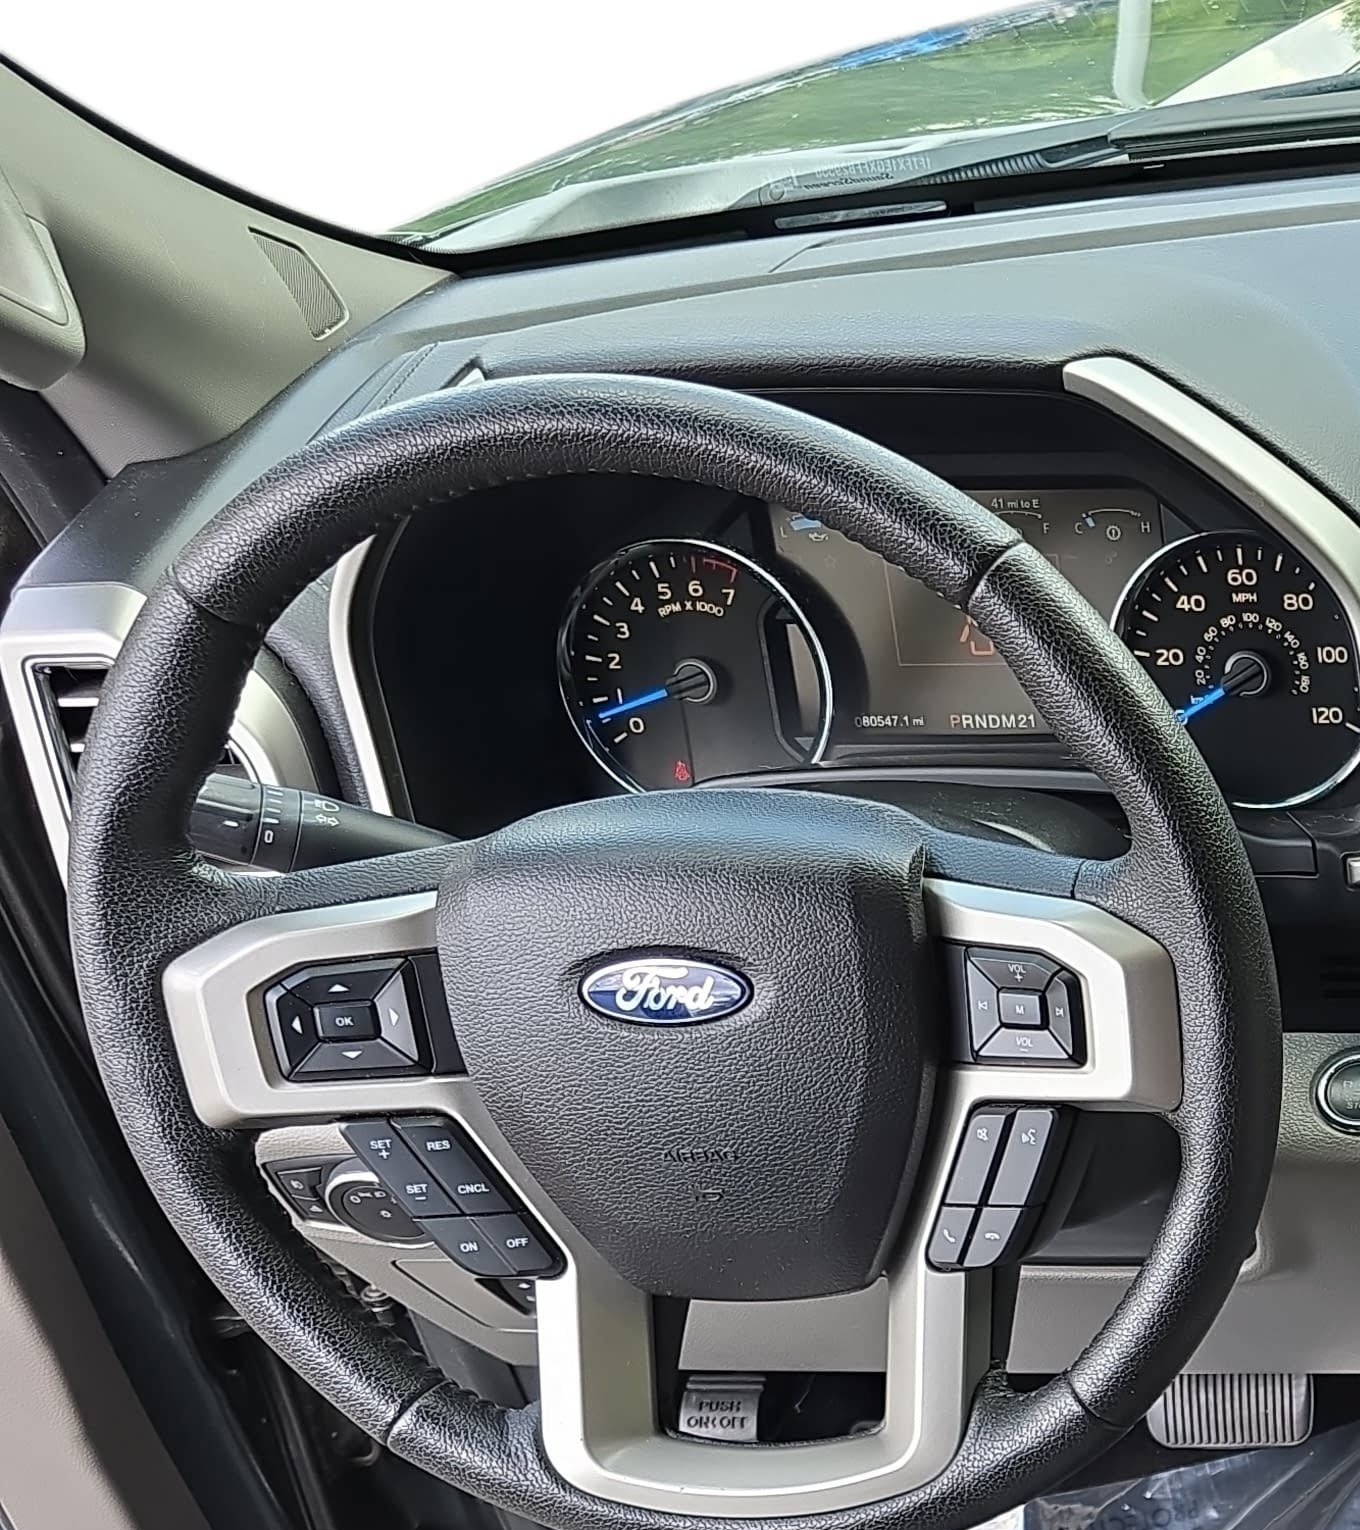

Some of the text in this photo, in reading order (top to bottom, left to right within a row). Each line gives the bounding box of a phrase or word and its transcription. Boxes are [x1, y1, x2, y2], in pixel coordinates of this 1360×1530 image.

[991, 498, 1005, 508] 41
[1043, 523, 1050, 534] F
[1227, 568, 1258, 586] 60
[657, 583, 672, 601] 5
[687, 580, 704, 597] 6
[721, 588, 736, 606] 7
[629, 597, 645, 614] 4
[1175, 594, 1206, 612] 40
[1232, 592, 1258, 603] MPH
[1283, 593, 1314, 611] 80
[658, 601, 724, 619] RPM X 1000
[1242, 612, 1260, 624] 100
[1219, 614, 1237, 629] 80
[1264, 615, 1283, 633] 120
[615, 622, 631, 639] 3
[1203, 626, 1219, 643] 60
[1283, 630, 1301, 649] 140
[607, 653, 622, 670] 2
[1155, 648, 1185, 666] 20
[1194, 646, 1207, 664] 40
[1296, 651, 1310, 671] 160
[1316, 646, 1349, 664] 100
[1194, 669, 1207, 686] 20
[616, 687, 624, 704] 1
[950, 714, 1037, 729] PRNDM21
[1311, 706, 1343, 724] 120
[628, 717, 645, 734] 0
[1008, 963, 1028, 975] VOL
[615, 965, 716, 1012] Ford
[1015, 1003, 1026, 1016] M
[335, 1015, 355, 1028] OK
[1014, 1036, 1034, 1048] VOL
[369, 1138, 392, 1152] SET
[426, 1138, 452, 1152] RES
[405, 1182, 429, 1196] SET
[456, 1182, 490, 1195] CNCL
[459, 1240, 479, 1255] ON
[505, 1235, 530, 1250] OFF
